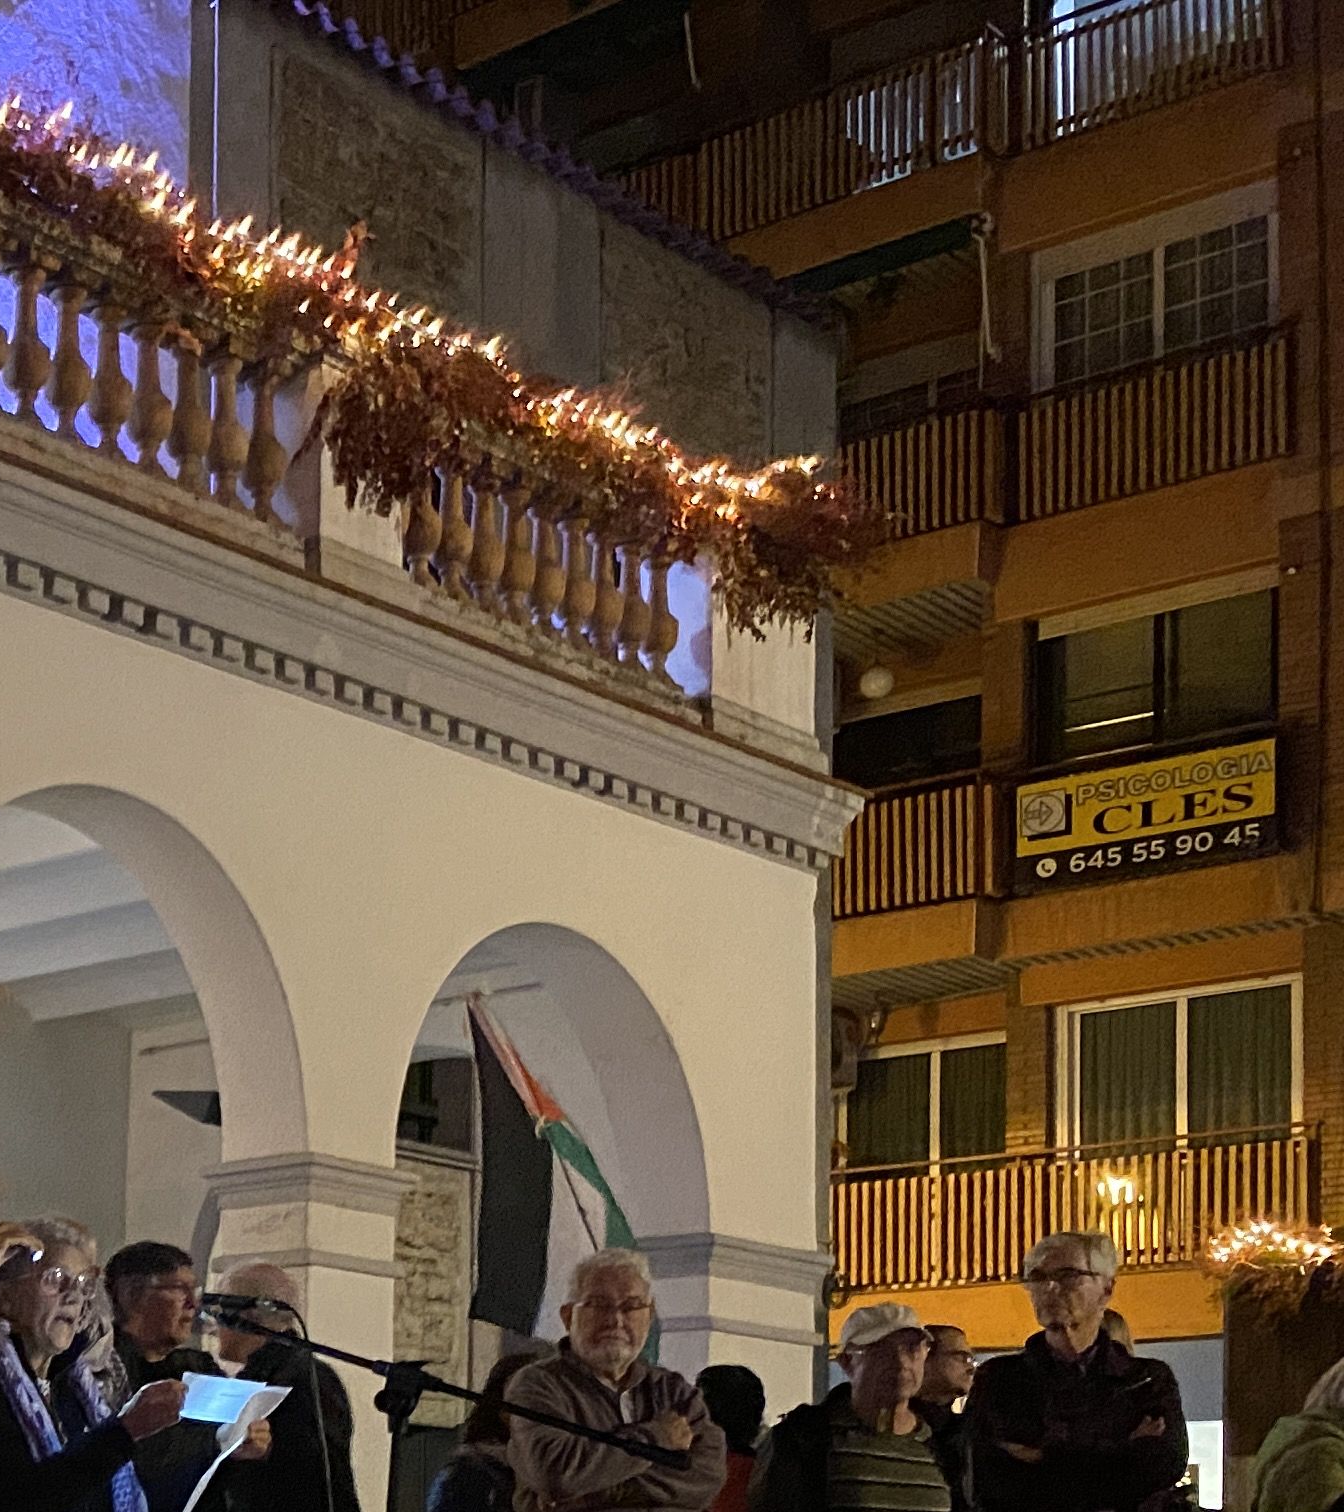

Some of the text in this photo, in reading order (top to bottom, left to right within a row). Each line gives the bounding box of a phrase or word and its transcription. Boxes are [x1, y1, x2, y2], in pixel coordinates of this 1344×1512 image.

[1076, 751, 1273, 806] PSICOLOGIA
[1092, 782, 1254, 835] CLES
[1069, 823, 1260, 873] 645 55 90 45
